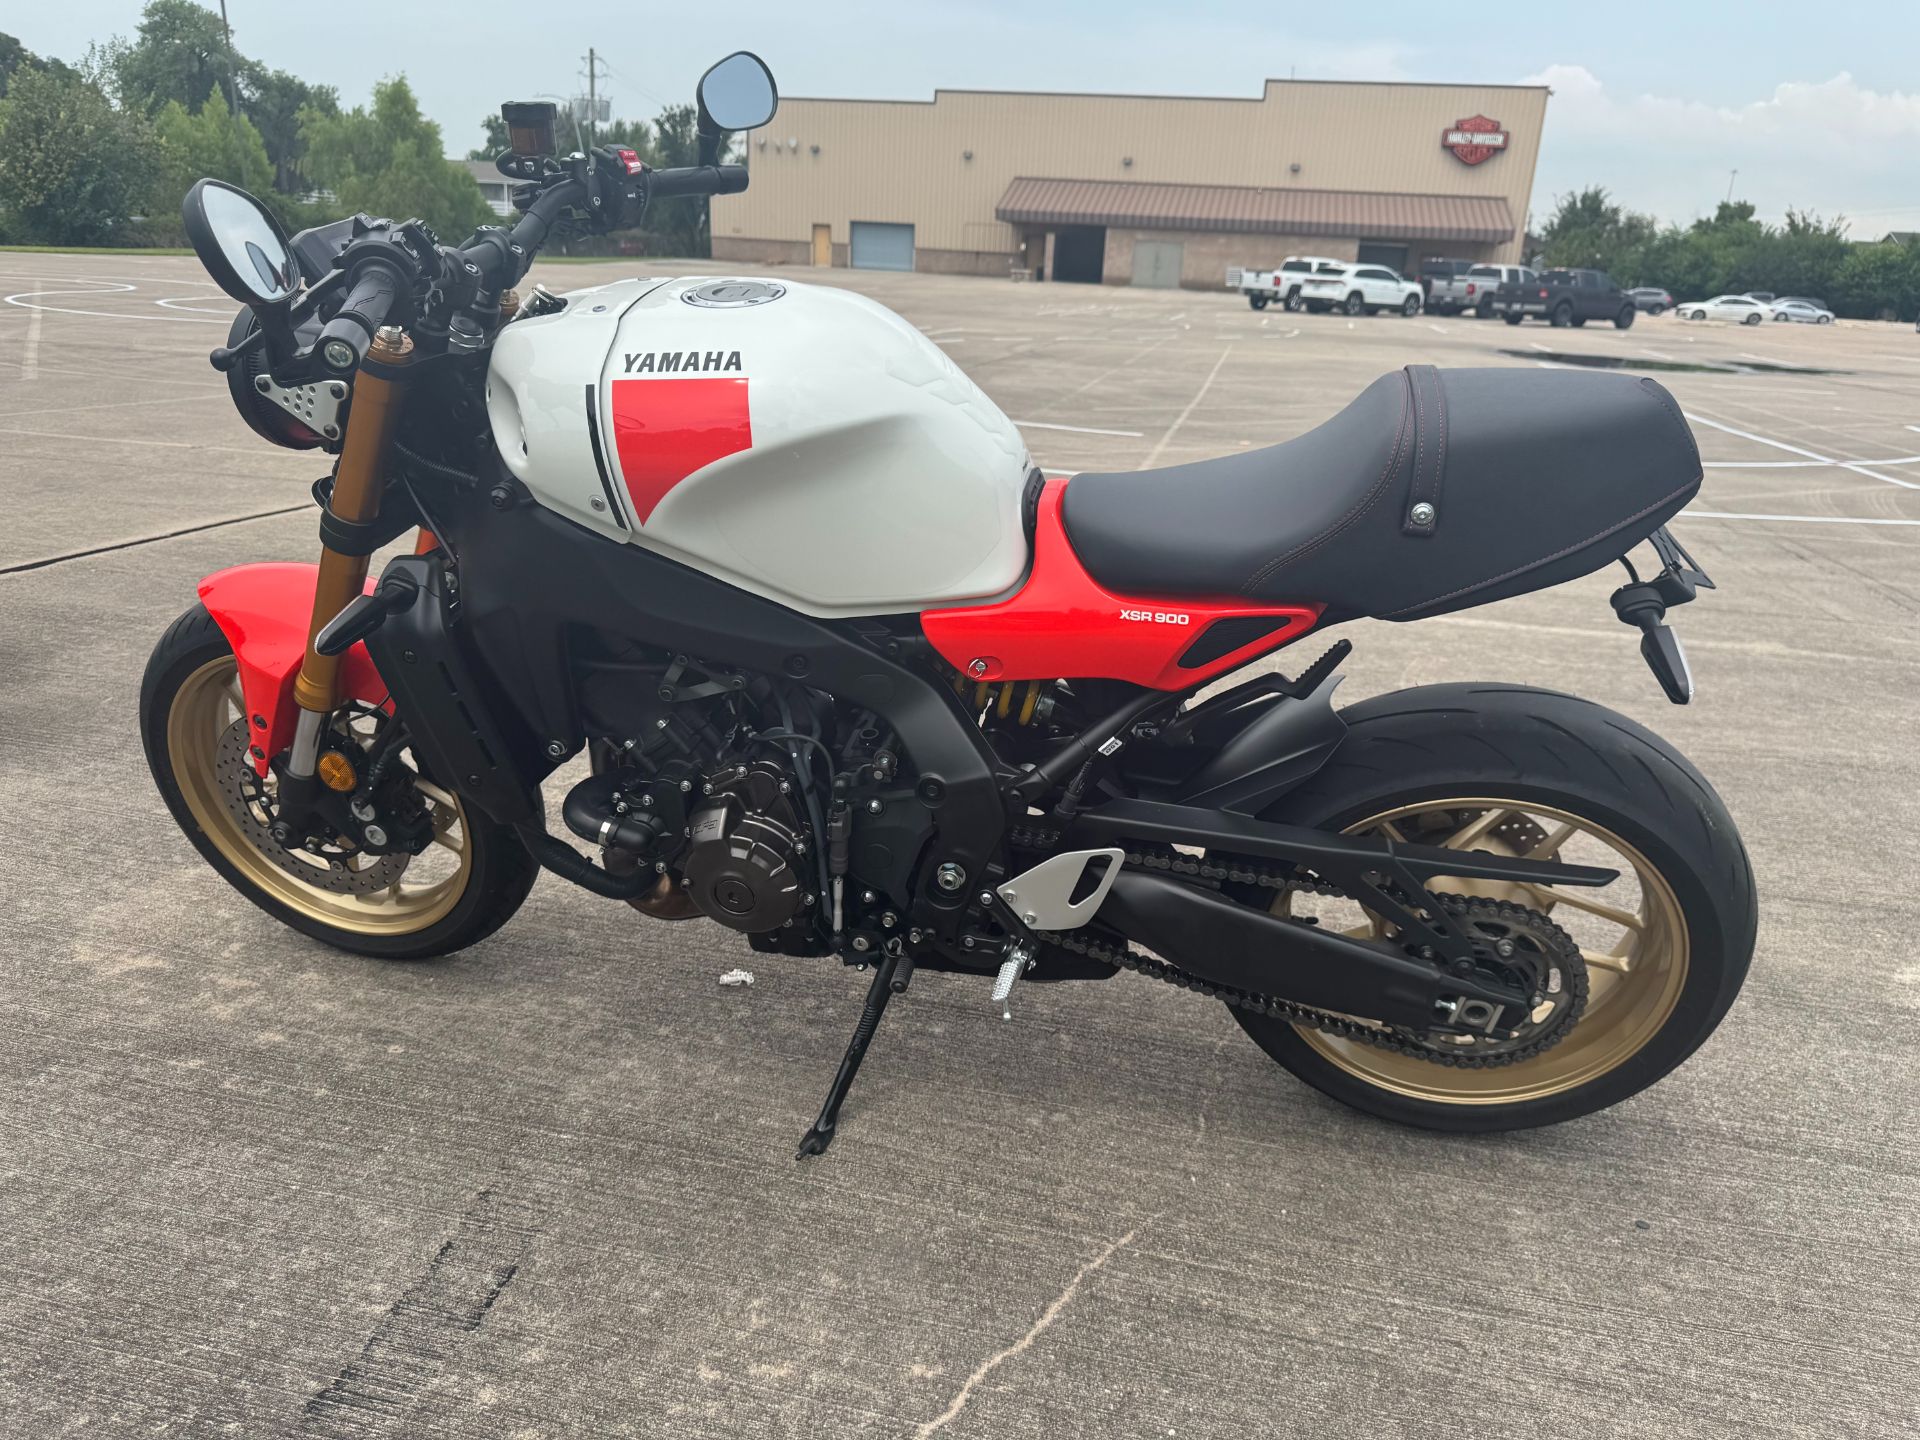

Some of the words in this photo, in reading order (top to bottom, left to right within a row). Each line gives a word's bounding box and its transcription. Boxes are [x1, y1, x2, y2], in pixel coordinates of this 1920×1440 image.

[624, 350, 742, 373] YAMAHA
[1119, 609, 1153, 622] XSR
[1154, 612, 1190, 625] 900
